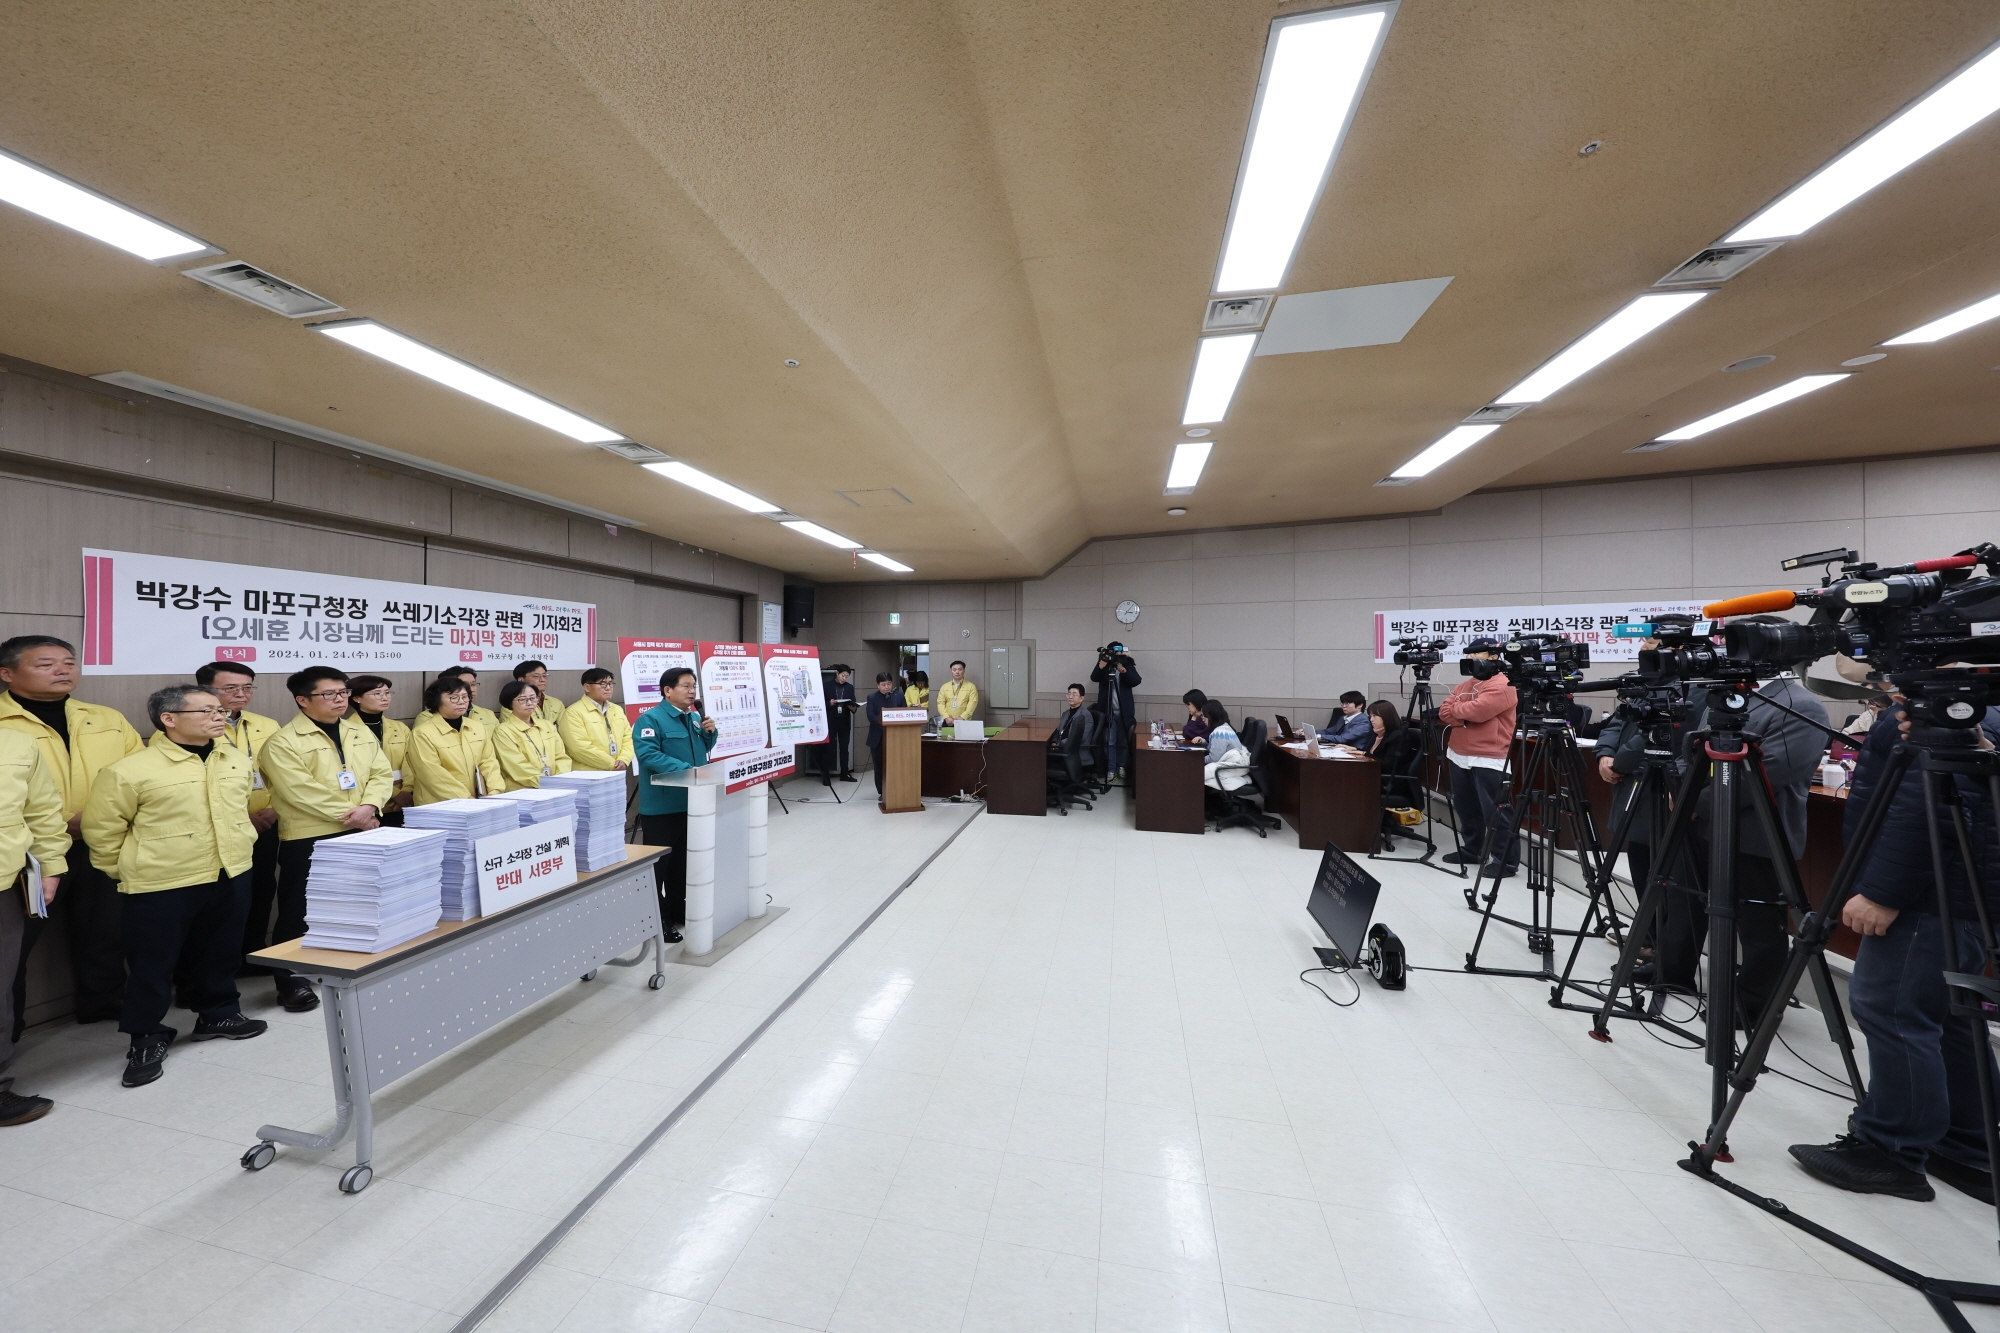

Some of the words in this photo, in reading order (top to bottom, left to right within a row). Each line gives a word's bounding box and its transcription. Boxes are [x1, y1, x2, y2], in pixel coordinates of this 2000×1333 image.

[136, 580, 232, 612] 박강수
[243, 589, 369, 620] 마포구청장
[382, 600, 491, 627] 쓰레기소각장
[495, 610, 523, 630] 관련
[532, 613, 582, 632] 기자회견
[299, 621, 384, 645] 시장님께
[392, 625, 444, 646] 드리는
[450, 628, 495, 648] 마지막
[500, 631, 526, 648] 정책
[1391, 620, 1429, 634] 박강수
[1433, 619, 1499, 634] 마포구청장
[1508, 616, 1594, 632] 쓰레기소각장
[222, 648, 246, 659] 일시
[268, 650, 304, 659] 2024.
[309, 650, 328, 659] 01.
[374, 651, 402, 660] 15:00
[463, 652, 478, 660] 장소
[488, 653, 513, 661] 마포구청
[1722, 761, 1730, 786] sachtler
[484, 856, 503, 872] 신규
[507, 847, 533, 865] 소각장
[535, 841, 552, 856] 건설
[554, 836, 570, 850] 계획
[496, 868, 523, 891] 반대
[529, 855, 564, 879] 서명부
